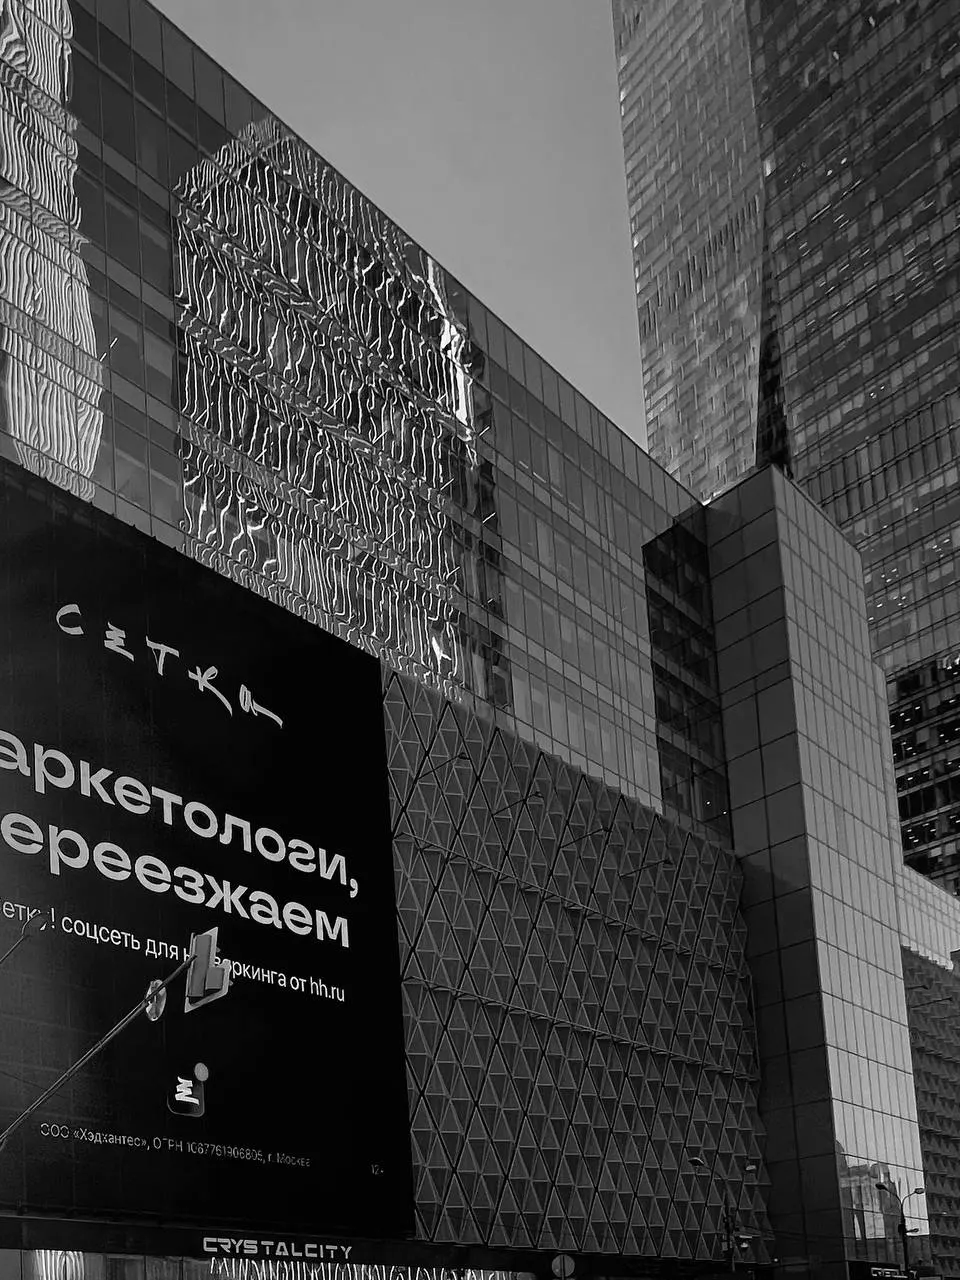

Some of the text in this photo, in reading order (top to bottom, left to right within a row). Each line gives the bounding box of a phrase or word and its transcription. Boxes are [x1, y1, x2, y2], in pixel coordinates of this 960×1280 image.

[61, 915, 141, 950] соцсеть
[145, 938, 179, 961] для
[183, 947, 286, 988] нвркинга
[289, 975, 307, 993] от
[310, 976, 346, 1003] hh.ru
[40, 1122, 69, 1138] ООО
